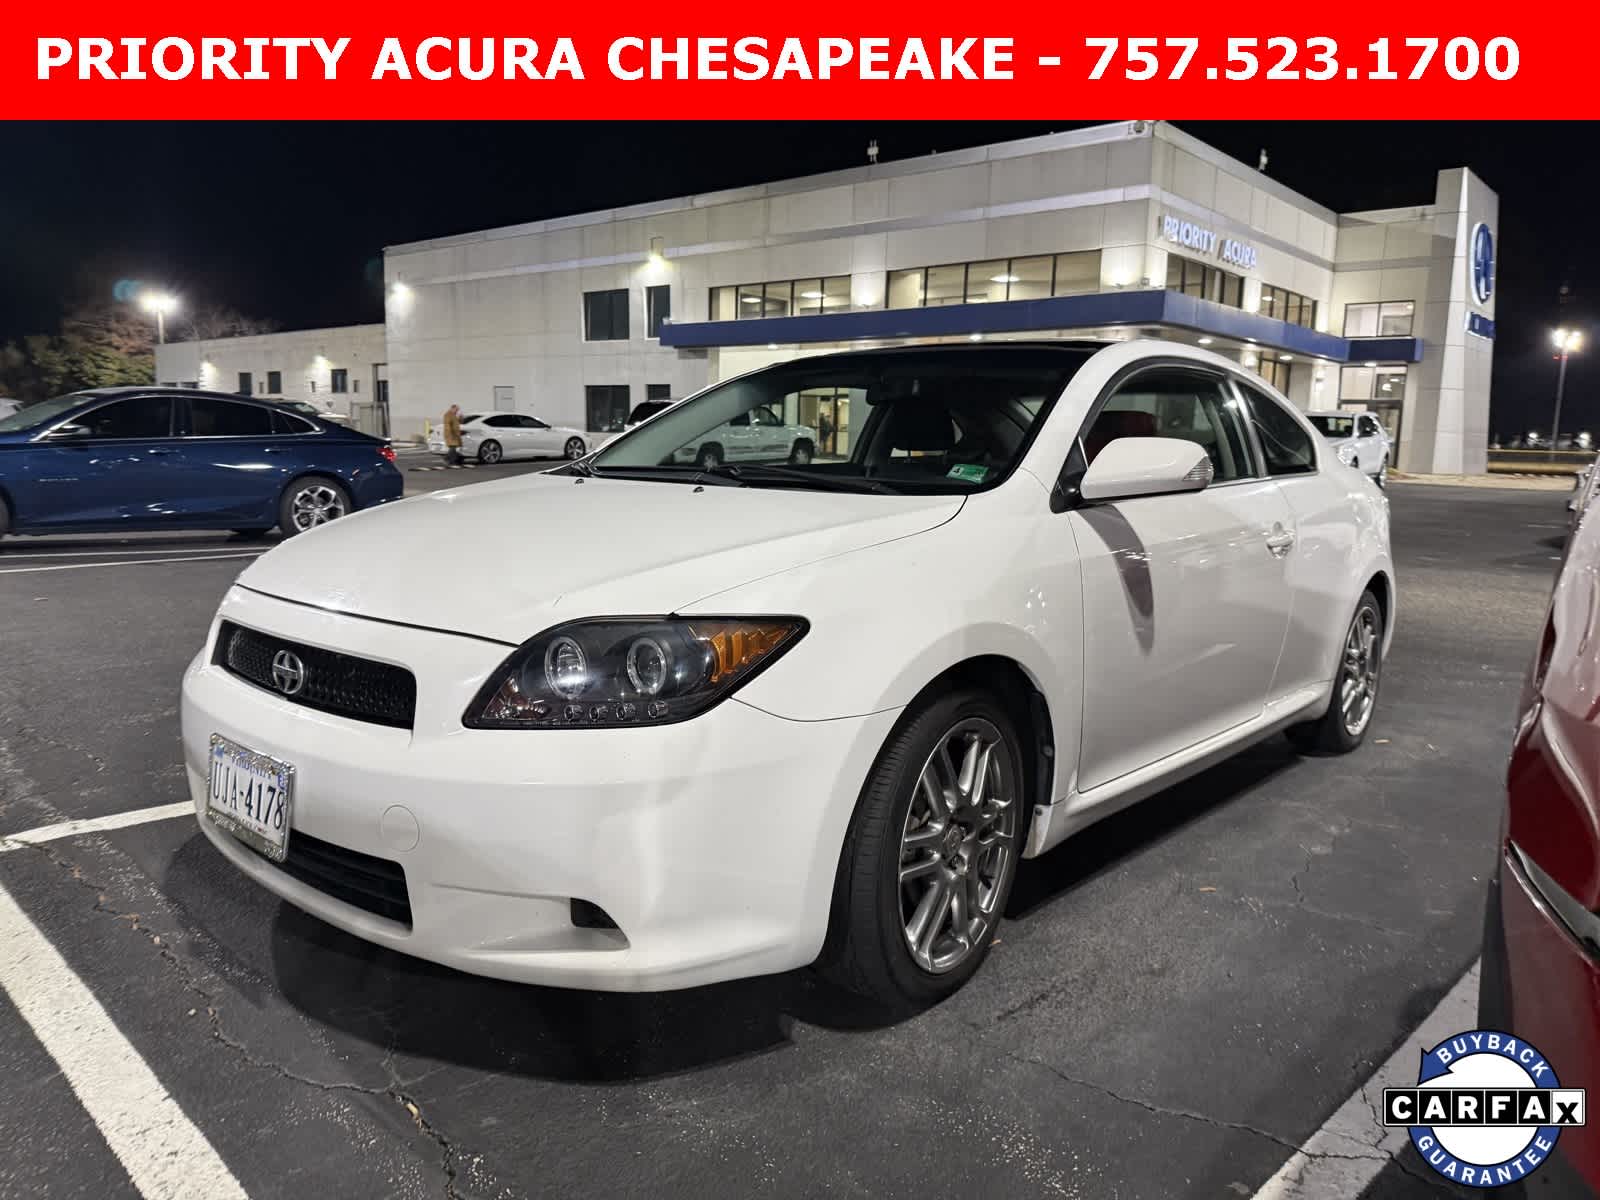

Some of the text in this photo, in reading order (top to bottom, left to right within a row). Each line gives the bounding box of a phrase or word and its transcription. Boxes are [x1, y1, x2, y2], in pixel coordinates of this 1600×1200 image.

[1163, 214, 1257, 268] PRIORITY ACURA
[212, 761, 284, 830] UJA-4178
